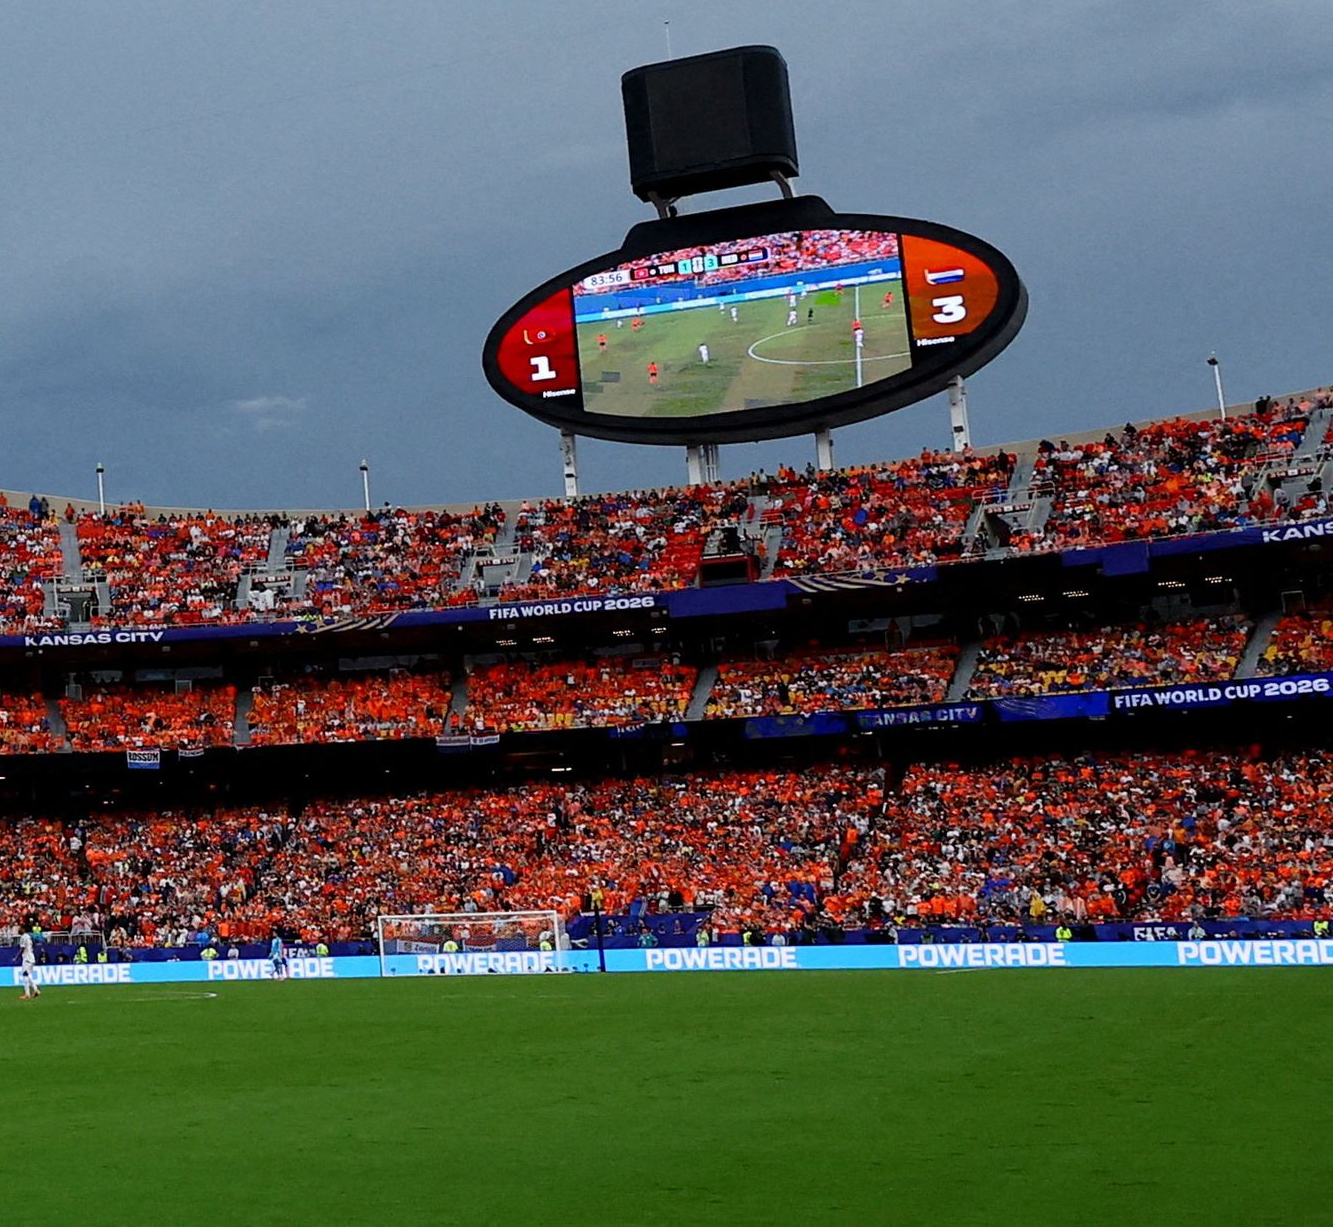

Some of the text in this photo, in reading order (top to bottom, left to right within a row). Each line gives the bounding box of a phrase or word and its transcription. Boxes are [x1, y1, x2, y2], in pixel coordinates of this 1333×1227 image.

[591, 274, 623, 286] 83:56
[682, 263, 688, 272] 1
[708, 258, 714, 268] 3
[932, 295, 967, 324] 3
[916, 336, 955, 347] Hisense
[530, 356, 556, 381] 1
[542, 388, 576, 398] Hisense
[489, 596, 655, 620] FIFA WORLD CUP 2026
[24, 631, 163, 646] KANSAS CITY
[1114, 678, 1330, 709] FIFA WORLD CUP 2026
[418, 951, 555, 973] POWERADE
[646, 947, 798, 970] POWERADE
[898, 943, 1066, 967] POWERADE
[208, 957, 334, 980] POWEADE
